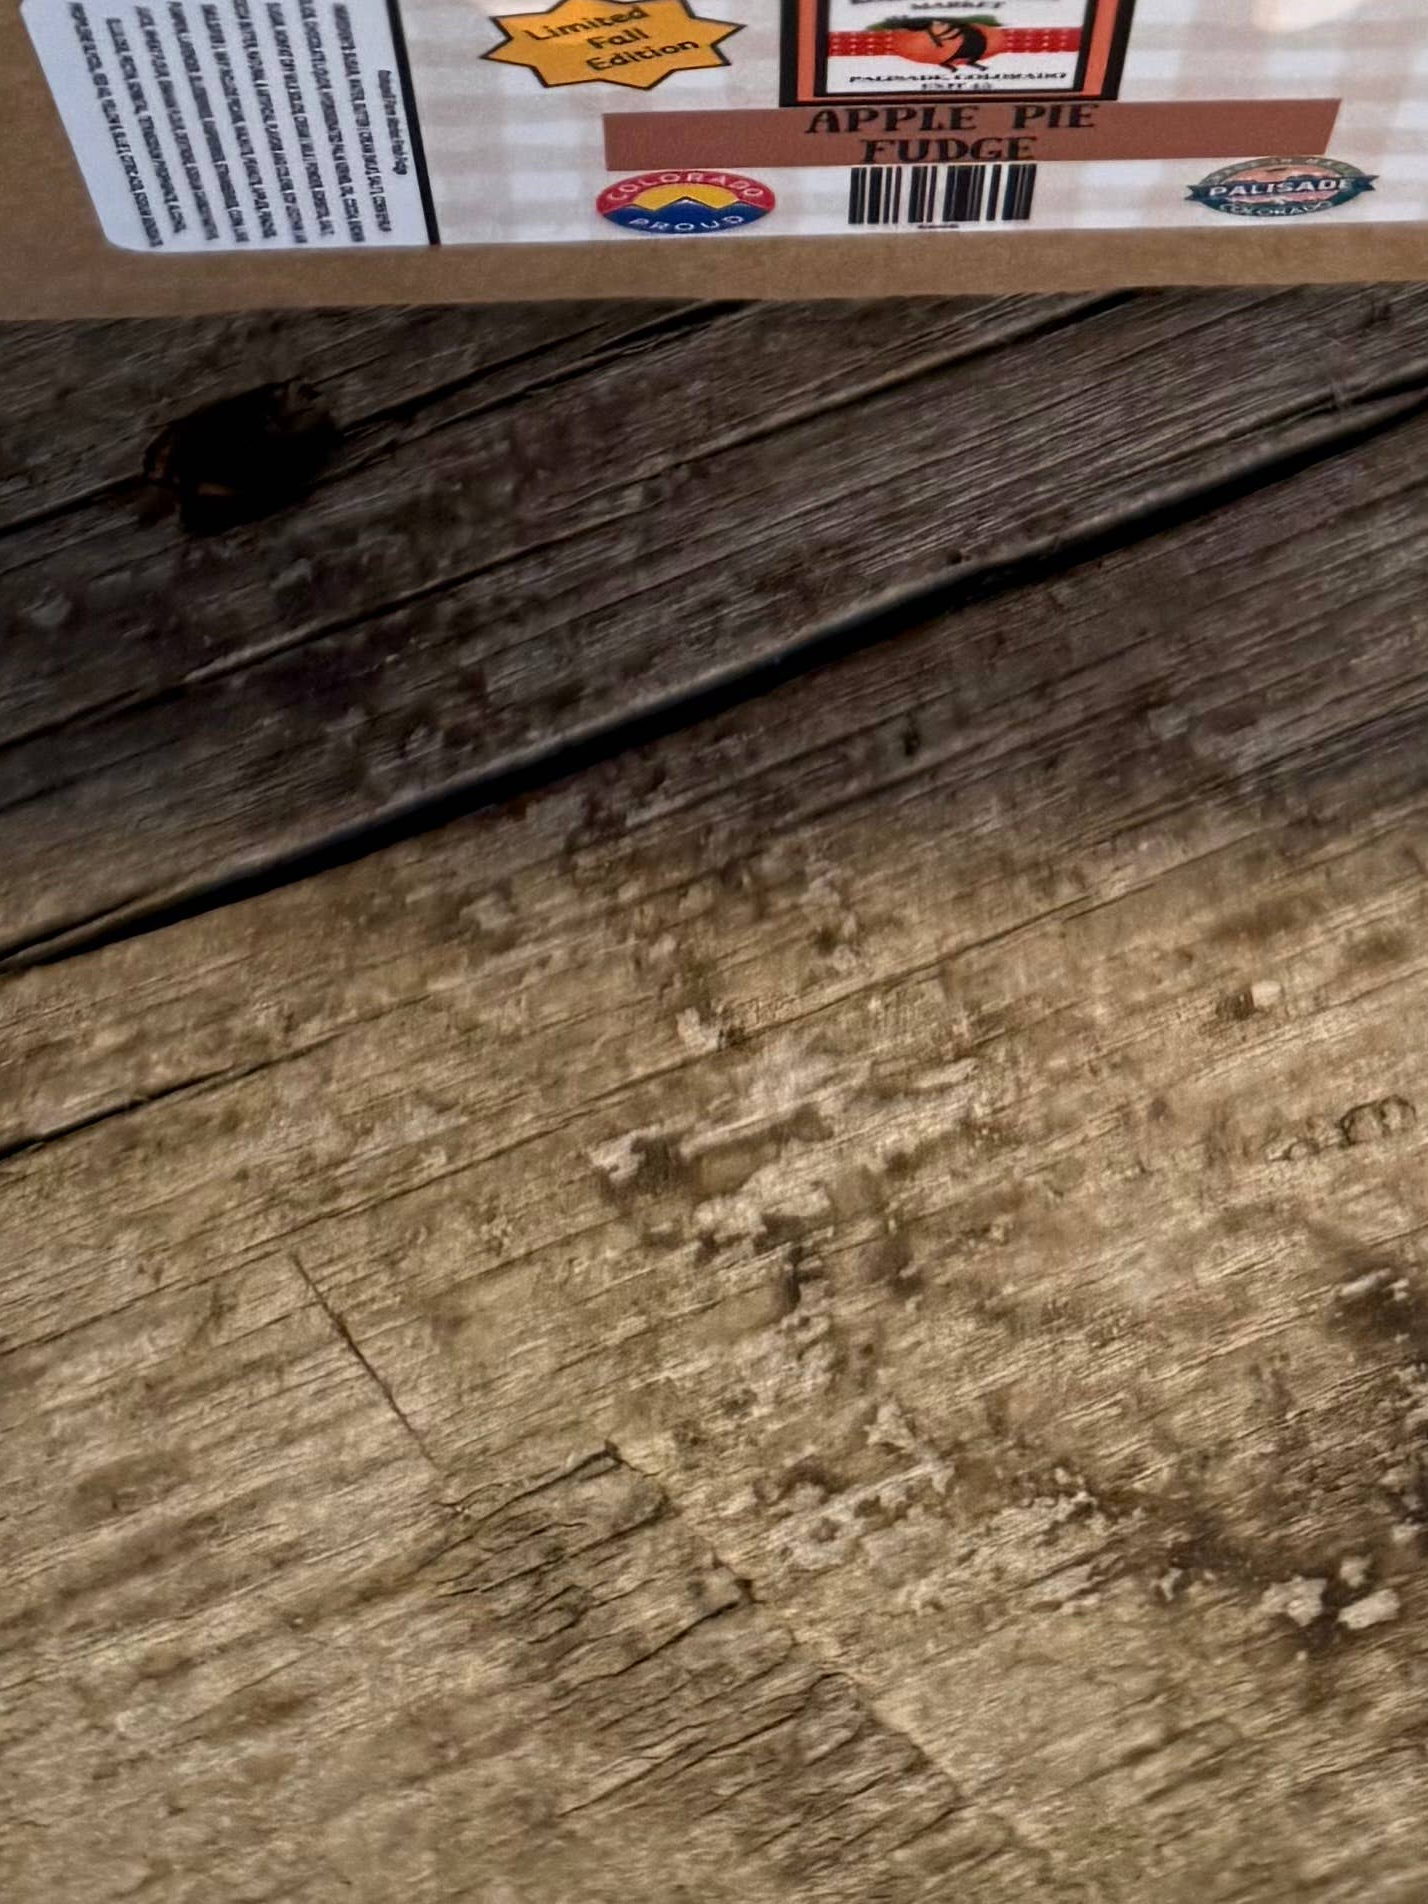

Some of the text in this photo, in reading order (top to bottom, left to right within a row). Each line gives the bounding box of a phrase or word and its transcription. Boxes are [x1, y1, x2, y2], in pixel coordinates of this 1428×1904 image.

[528, 6, 651, 43] Limited
[587, 30, 650, 52] Fall
[587, 37, 699, 72] Edition
[804, 103, 1100, 134] APPLE PIE
[860, 135, 1038, 163] FUDGE
[604, 171, 766, 204] COLORADO
[1208, 176, 1352, 198] PALISADE
[626, 214, 745, 234] PROUD
